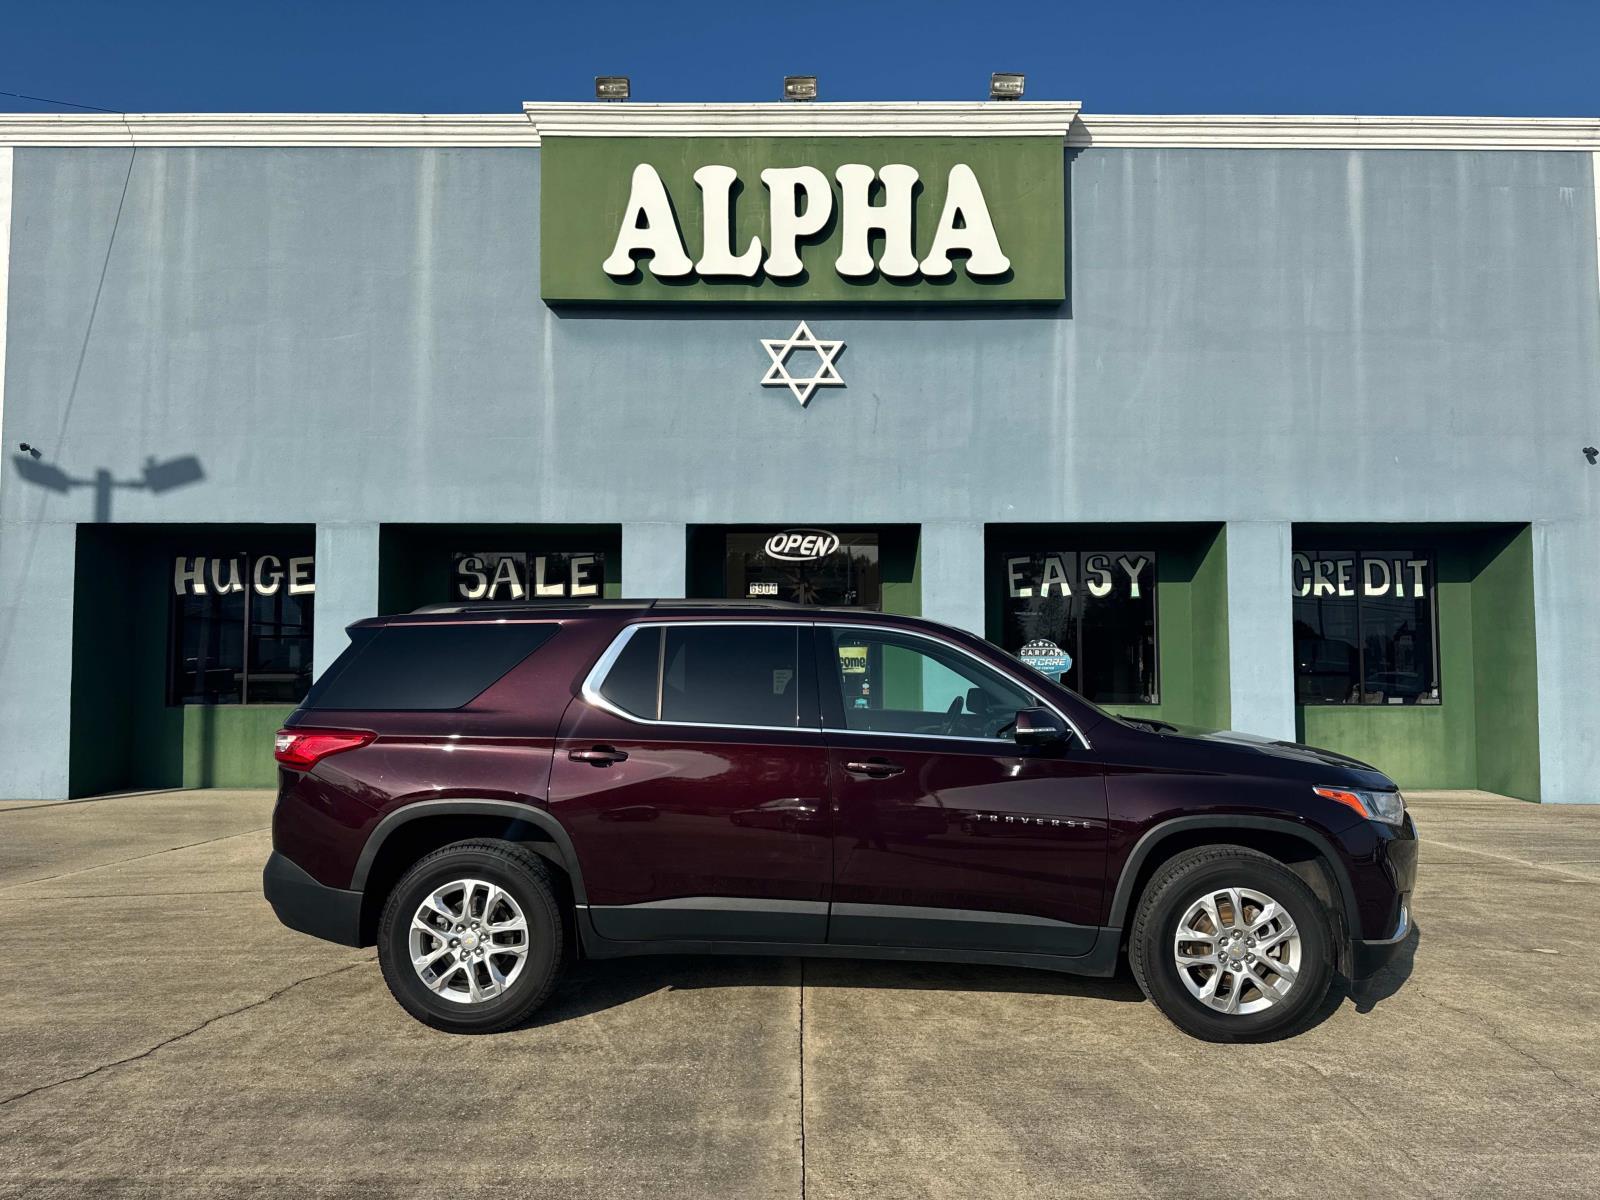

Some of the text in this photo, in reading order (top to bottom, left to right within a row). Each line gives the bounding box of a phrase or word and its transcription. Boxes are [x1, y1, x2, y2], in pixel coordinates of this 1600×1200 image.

[602, 163, 1011, 278] ALPHA
[770, 533, 831, 556] OPEN
[174, 555, 315, 596] HUGE
[457, 555, 599, 599] SALE
[751, 583, 777, 594] 6904
[1007, 553, 1149, 600] EASY
[1293, 550, 1428, 598] CREDIT
[1020, 649, 1063, 657] CARFAX
[1037, 658, 1067, 666] CARE
[976, 814, 1090, 828] TRAVERSE
